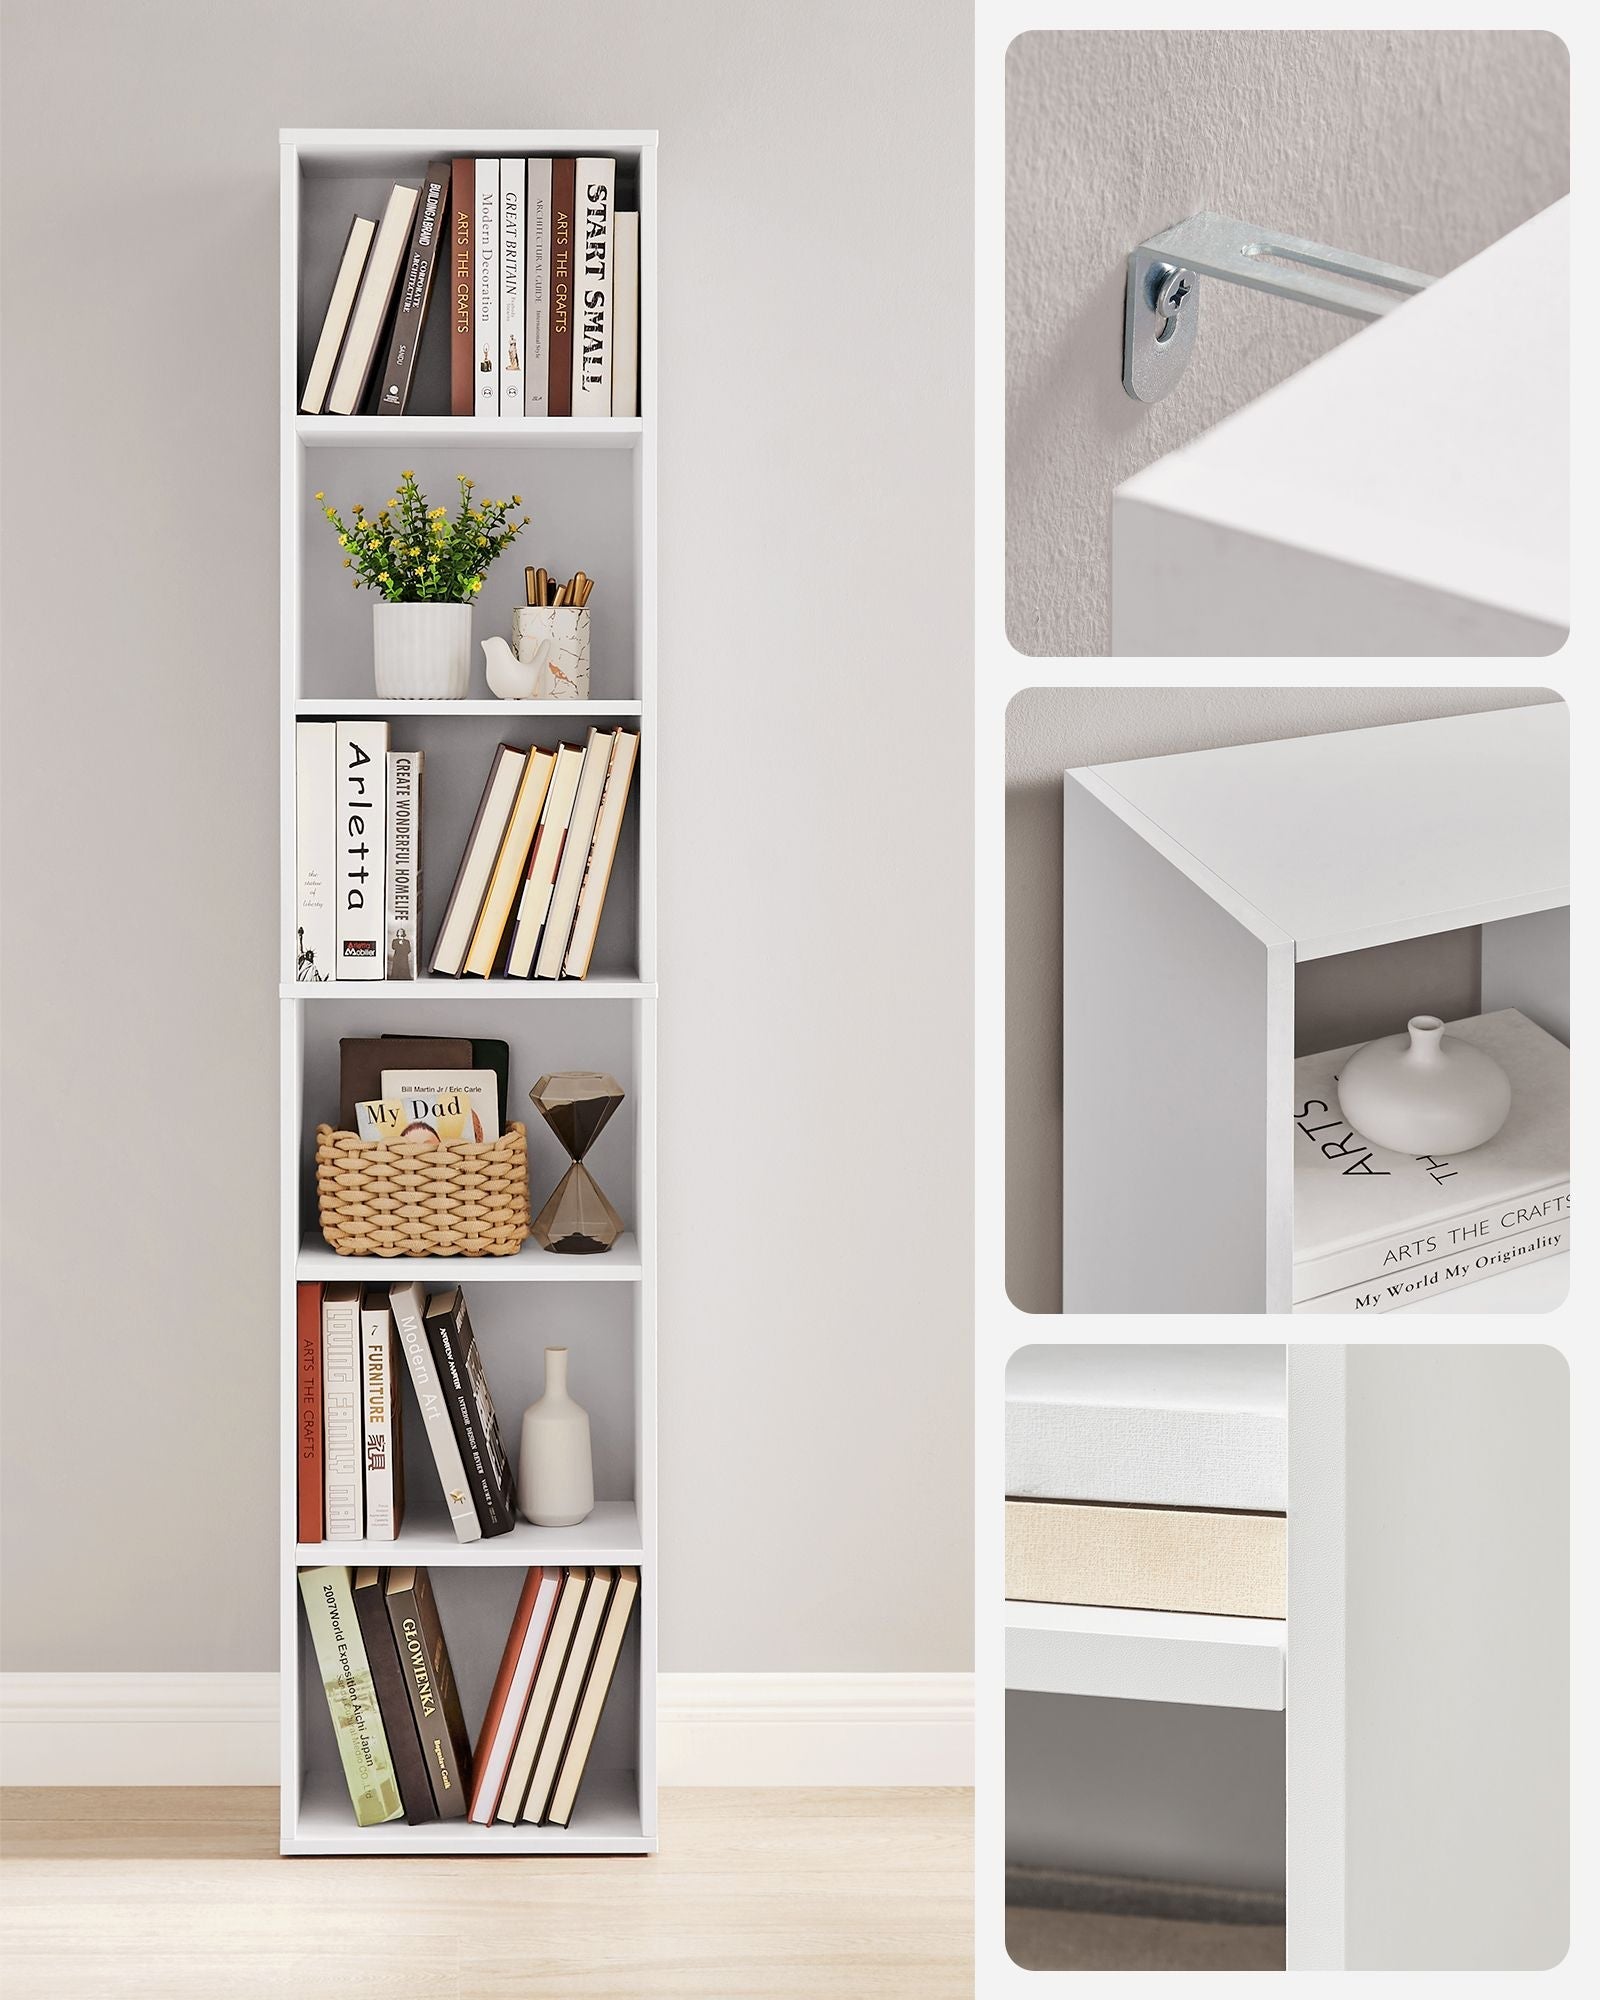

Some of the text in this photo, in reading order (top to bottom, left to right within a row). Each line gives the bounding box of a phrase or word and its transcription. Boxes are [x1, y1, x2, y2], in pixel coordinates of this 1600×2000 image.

[505, 192, 518, 238] GREAT
[403, 252, 421, 313] ARCHITECTURE
[412, 260, 428, 308] CORPORATE
[457, 211, 469, 333] ARTS THE CRAFTS
[482, 193, 493, 322] Modern Decoration
[505, 240, 518, 295] BRITAIN
[555, 211, 568, 333] ARTS THE CRAFTS
[582, 184, 608, 393] START SMALL
[347, 741, 373, 911] Arletta
[395, 758, 411, 921] CREATE WONDERFUL HOMELIFE
[366, 1096, 462, 1128] My Dad
[1294, 1100, 1391, 1175] ARTS
[1415, 1155, 1458, 1185] TH
[1354, 1234, 1562, 1310] My World My Originality
[1383, 1236, 1437, 1266] ARTS
[1447, 1219, 1490, 1244] THE
[371, 1325, 379, 1336] 7
[401, 1315, 441, 1420] Modern Art
[303, 1339, 314, 1459] ARTS THE CRAFTS
[368, 1345, 385, 1424] FURNITURE
[367, 1434, 386, 1471] 家具
[457, 1396, 471, 1426] INTERIOR
[466, 1427, 478, 1450] DESIGN
[338, 1643, 357, 1701] Exposition
[352, 1704, 367, 1732] Aichi
[360, 1734, 374, 1767] Japan
